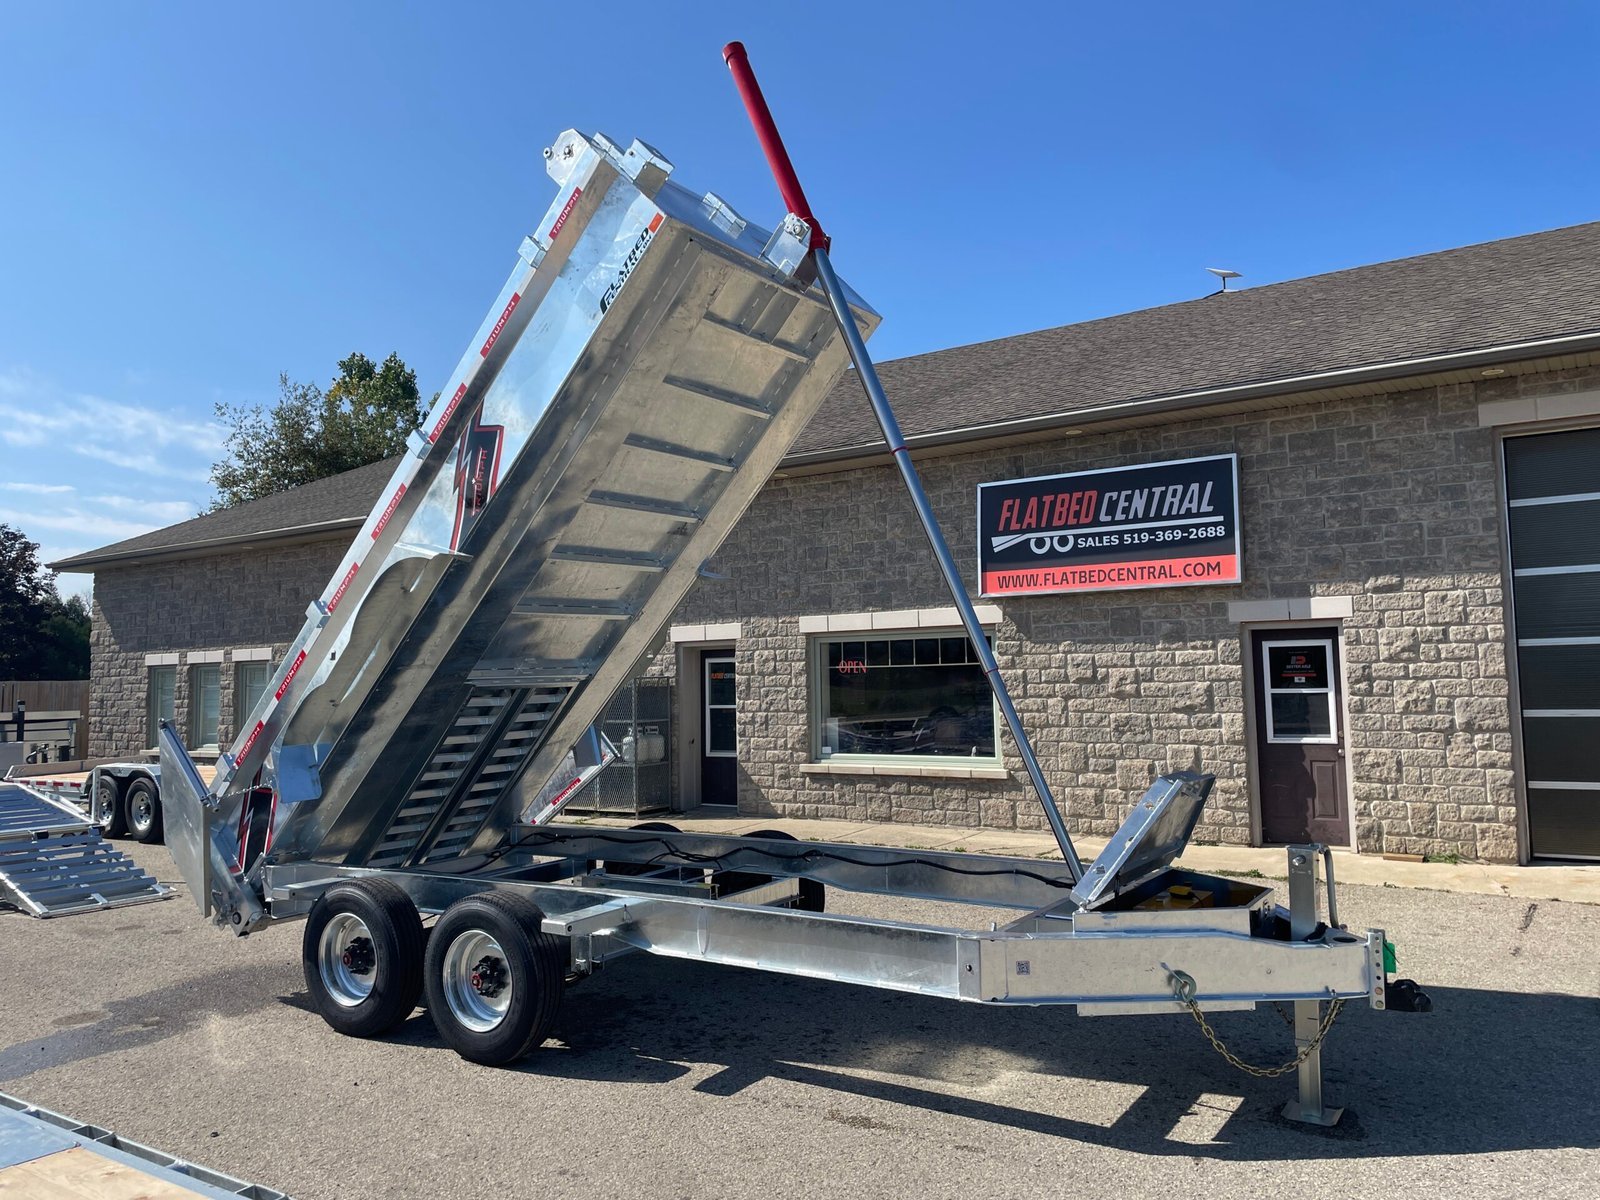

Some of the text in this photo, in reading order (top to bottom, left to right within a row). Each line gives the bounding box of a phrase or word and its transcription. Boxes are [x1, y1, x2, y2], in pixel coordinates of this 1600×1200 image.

[553, 193, 579, 234] TRIUMPH
[600, 227, 649, 315] FLATBED
[485, 301, 515, 349] TRIUMPH
[433, 391, 462, 435] TRIUMPH
[475, 449, 488, 513] TRIUMPH
[375, 491, 402, 533] TRIUMPH
[998, 481, 1214, 532] FLATBED CENTRAL
[1077, 525, 1226, 548] SALES 519-369-2688
[329, 569, 355, 609] TRIUMPH
[997, 561, 1221, 589] WWW.FLATBEDCENTRAL.COM
[279, 656, 303, 694] TRIUMPH
[838, 660, 867, 674] OPEN
[237, 727, 261, 763] TRIUMPH
